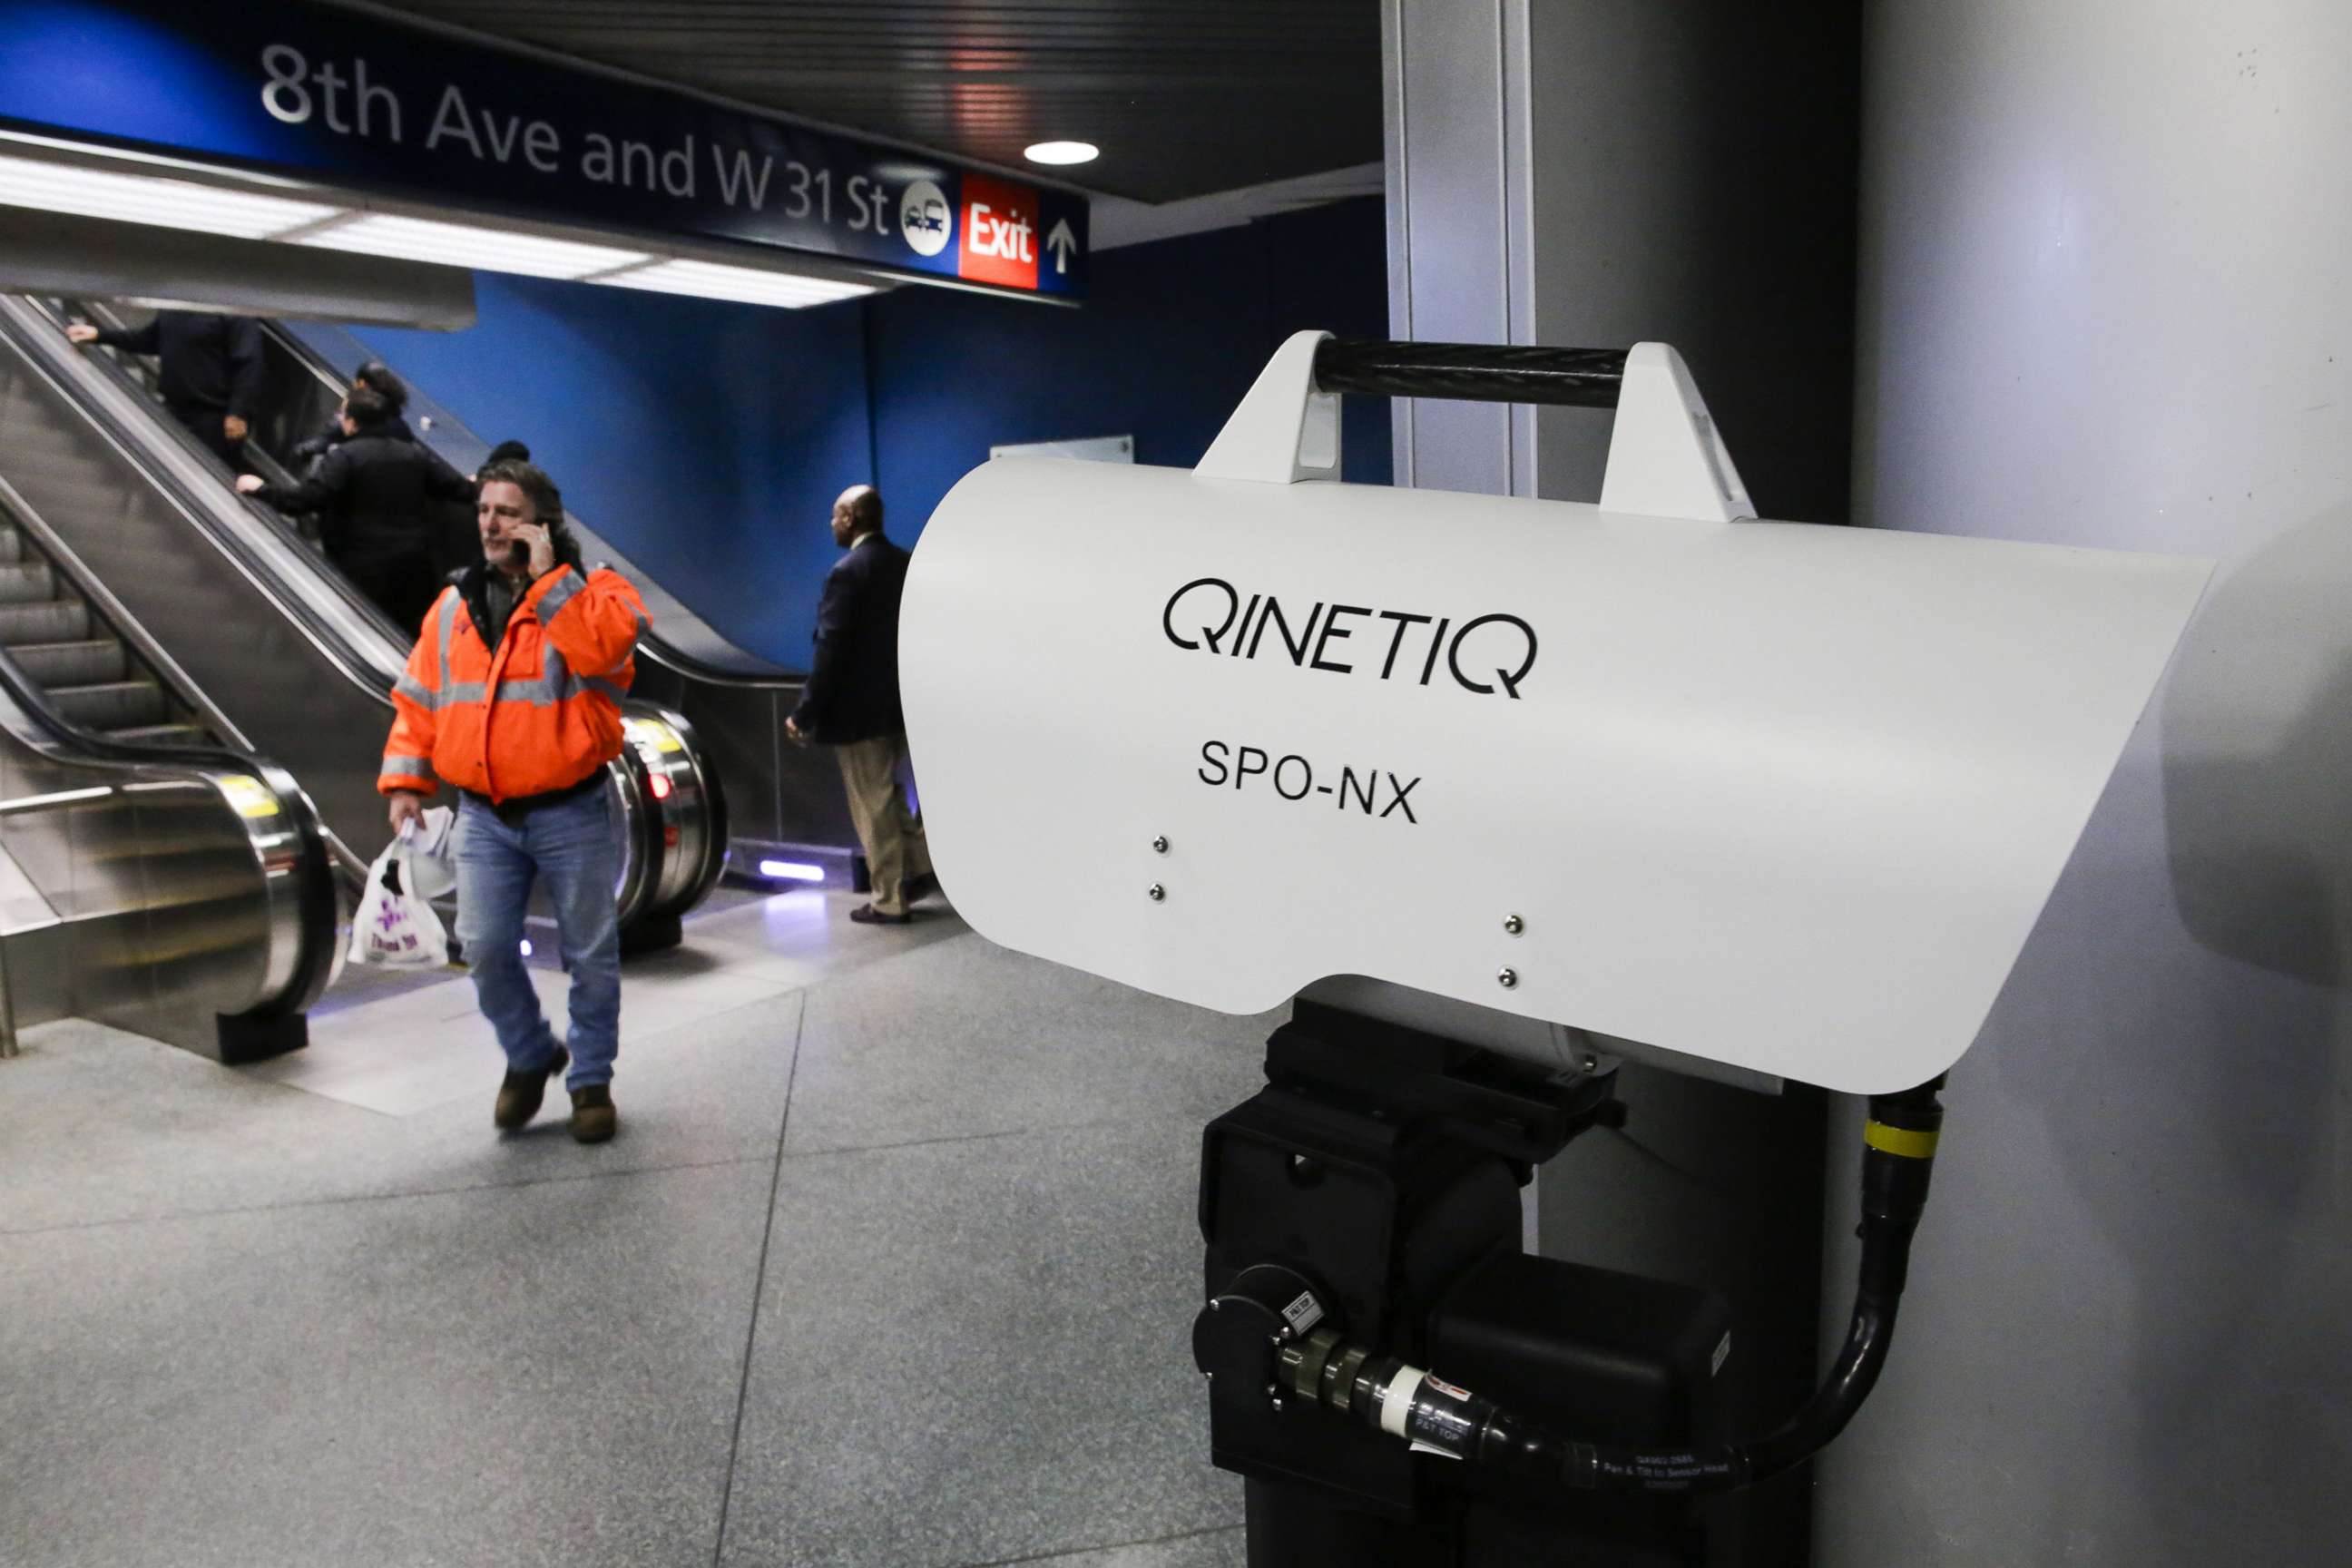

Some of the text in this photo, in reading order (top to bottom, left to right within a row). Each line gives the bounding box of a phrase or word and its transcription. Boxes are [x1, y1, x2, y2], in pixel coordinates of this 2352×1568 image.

[261, 44, 889, 236] 8th Ave and W 31 St
[968, 202, 1033, 264] Exit
[1163, 577, 1538, 699] QINETIQ
[1198, 740, 1421, 824] SPO-NX
[1439, 1427, 1459, 1441] TOP
